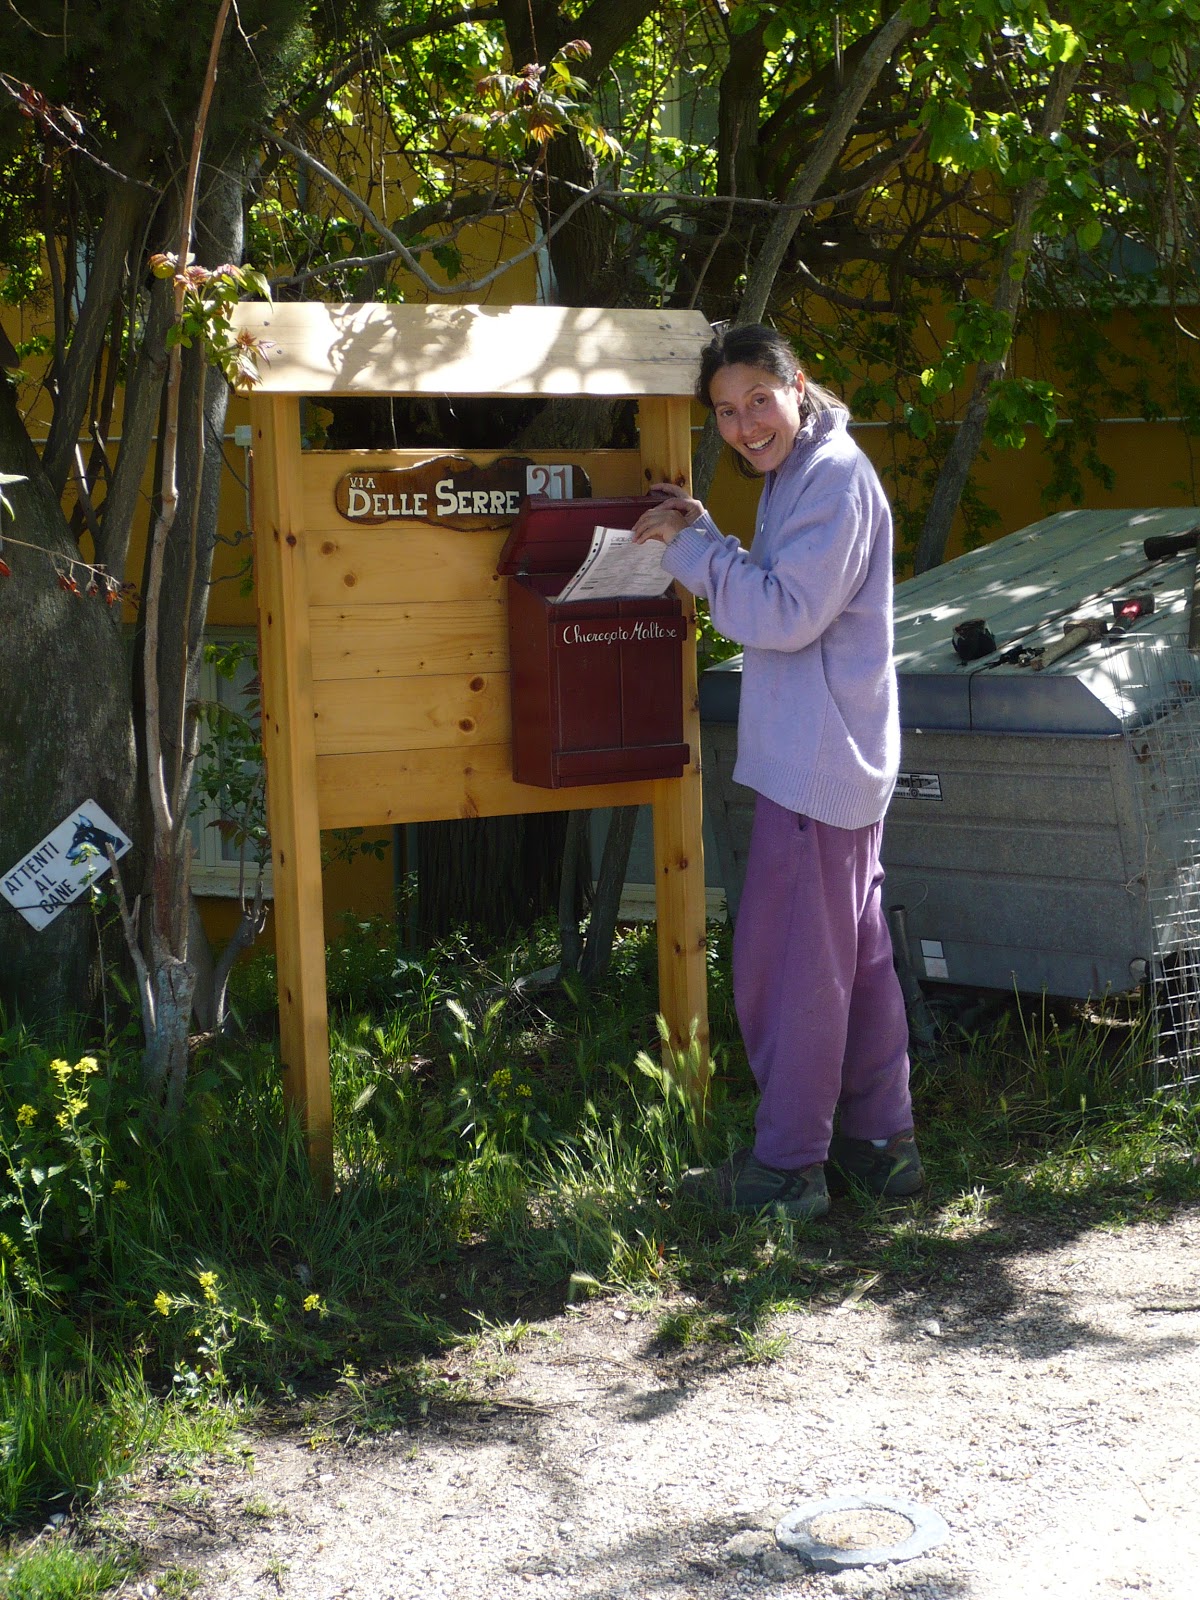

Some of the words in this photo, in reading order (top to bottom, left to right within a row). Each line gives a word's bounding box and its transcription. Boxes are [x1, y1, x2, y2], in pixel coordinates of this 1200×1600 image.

[347, 488, 428, 517] DELLE
[435, 479, 520, 516] SERRE
[350, 477, 376, 489] VIA
[4, 841, 60, 896] ATTENTI
[34, 874, 57, 897] AL
[39, 879, 77, 914] CANE
